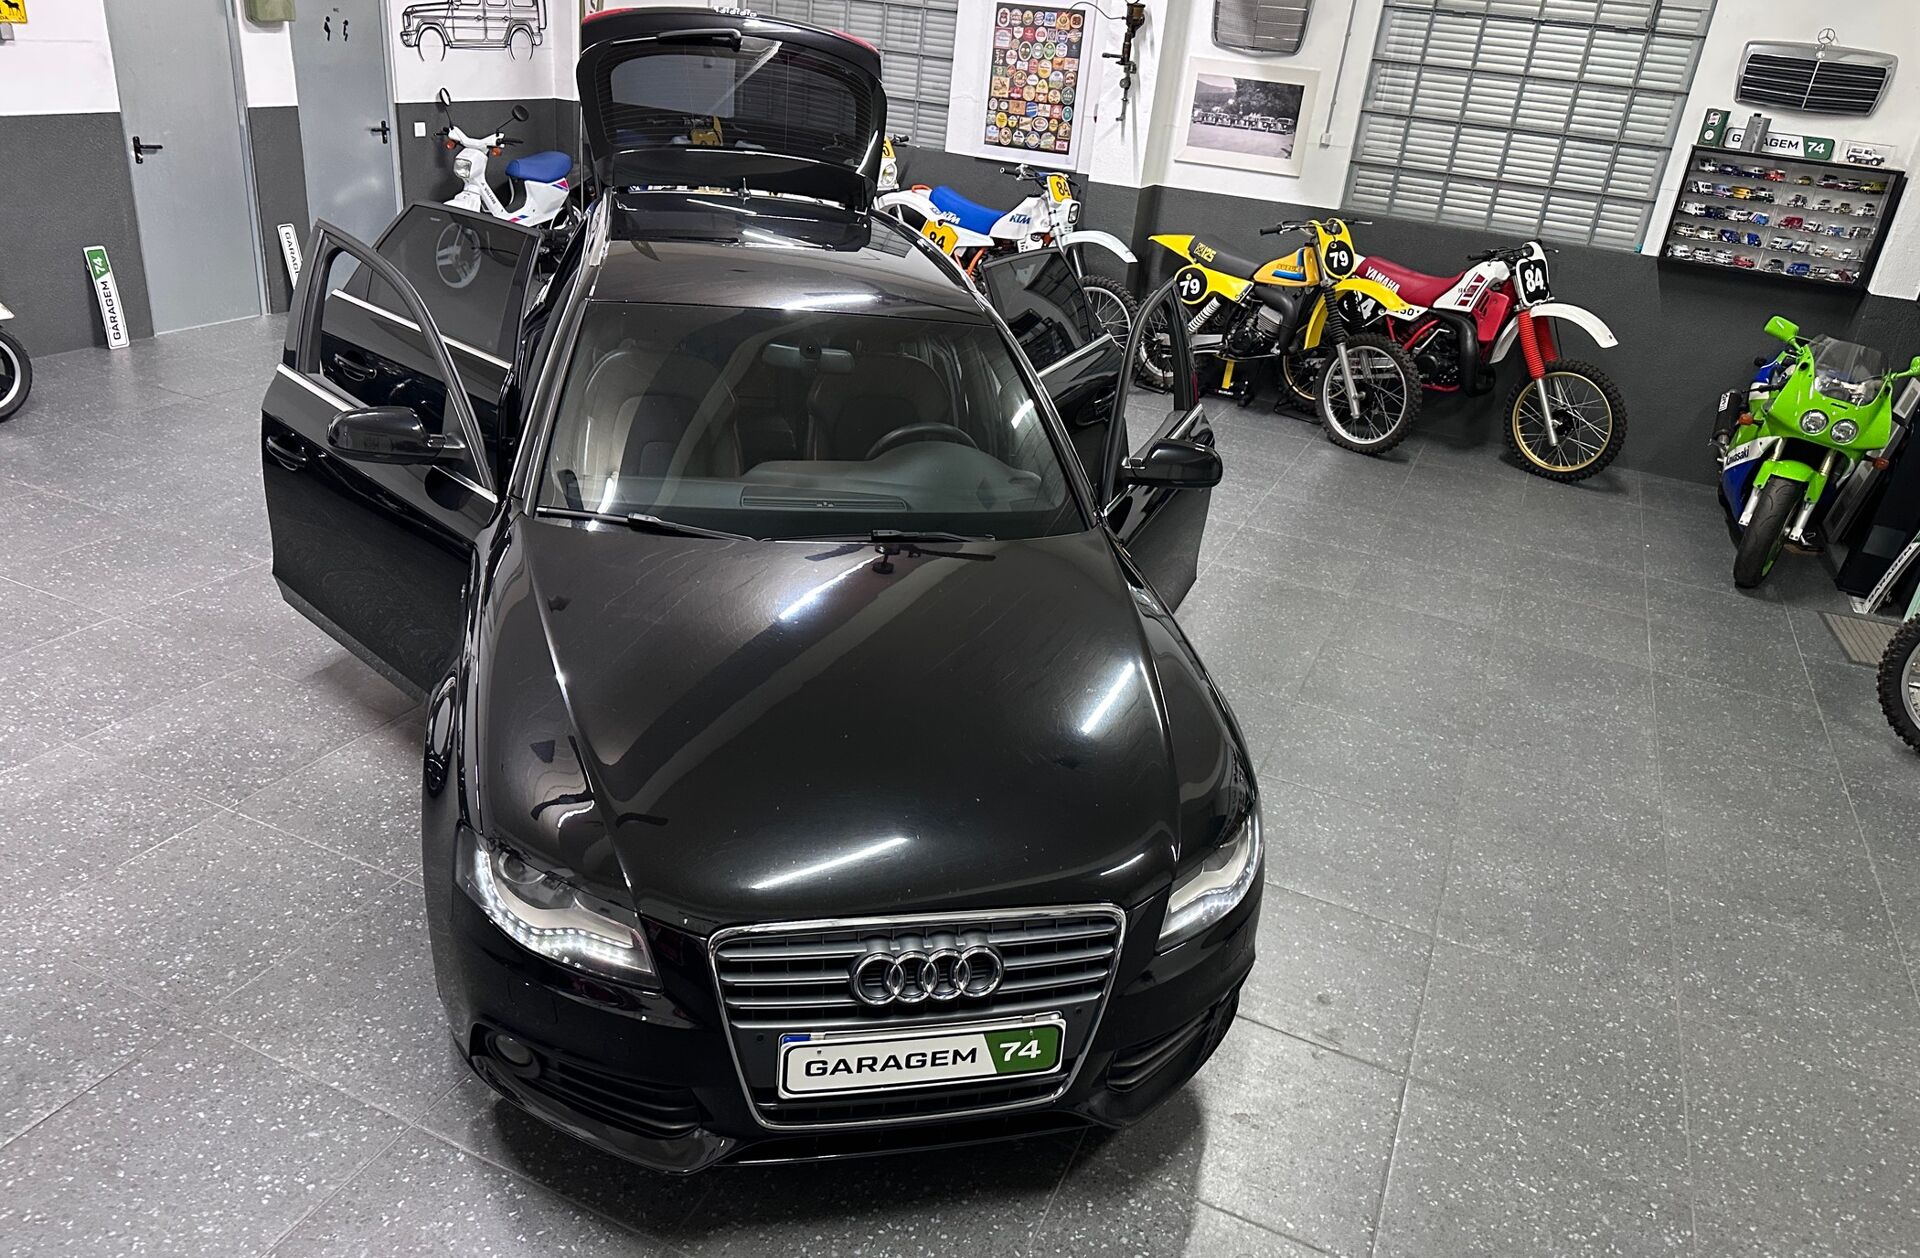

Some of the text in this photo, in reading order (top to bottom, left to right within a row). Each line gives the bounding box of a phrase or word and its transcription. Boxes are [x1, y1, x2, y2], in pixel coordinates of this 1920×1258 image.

[1731, 133, 1825, 154] GAGEM 74
[1056, 181, 1071, 197] 84
[1009, 213, 1031, 224] KTM
[285, 232, 299, 274] GARAG
[1329, 250, 1349, 269] 79
[1180, 279, 1200, 297] 79
[1365, 266, 1400, 294] YAMAHA
[1524, 267, 1544, 293] 84
[93, 256, 121, 340] GARAGEM 74
[805, 1039, 1041, 1077] GARAGEM 74
